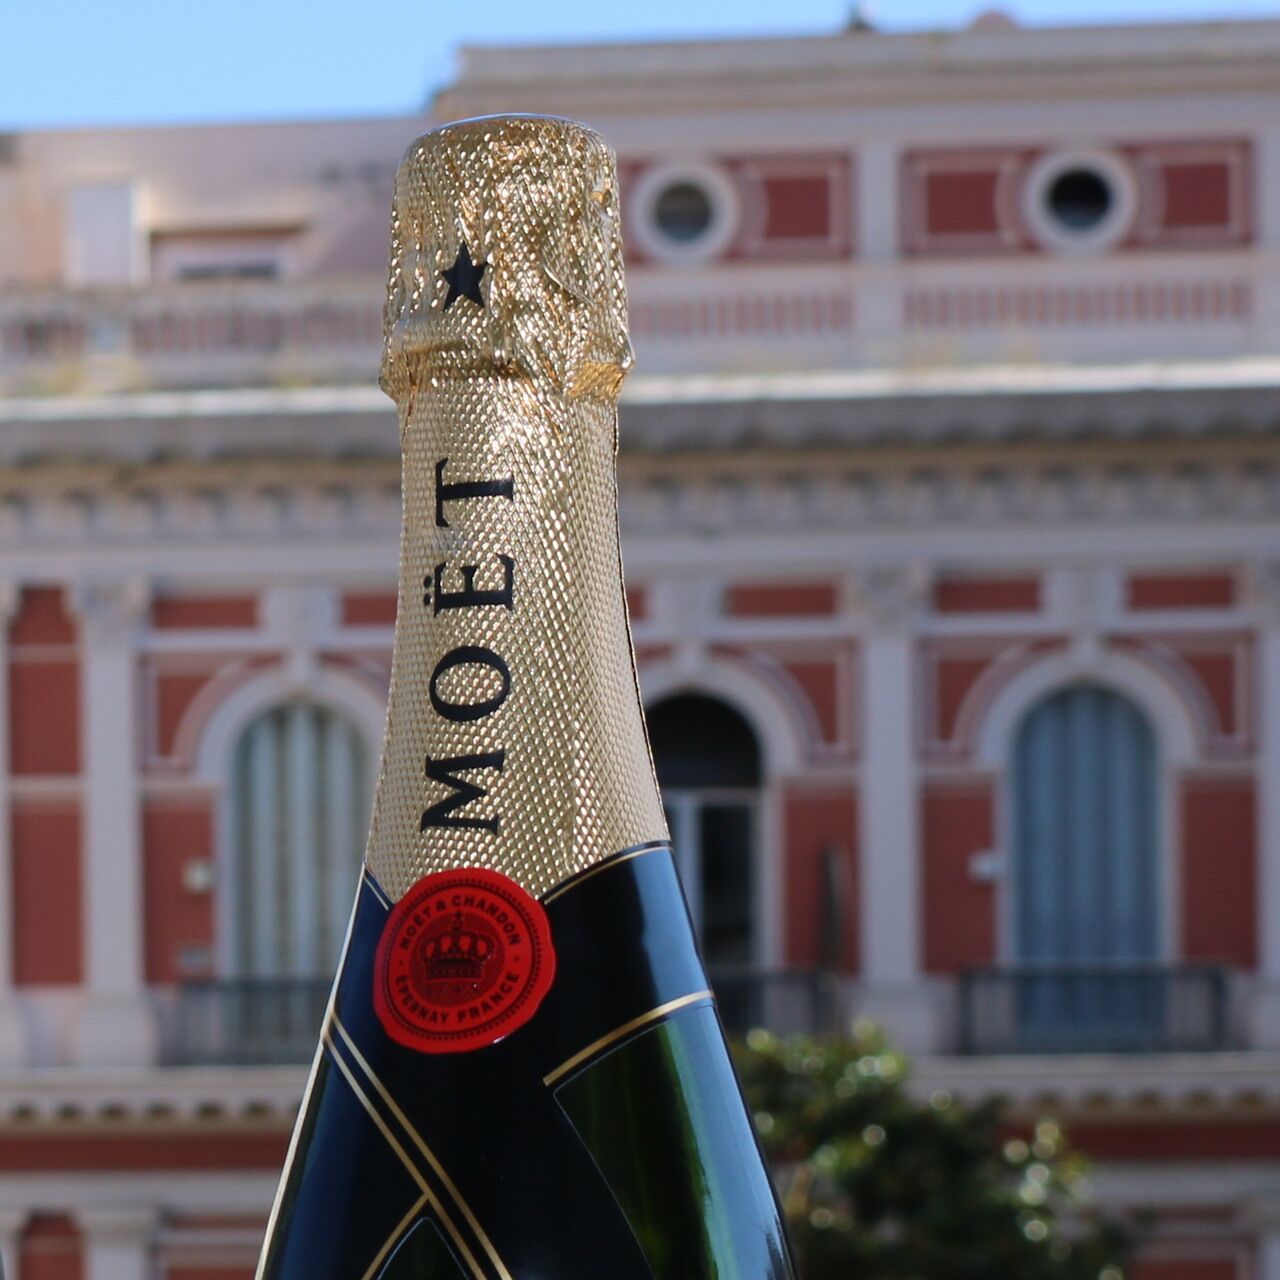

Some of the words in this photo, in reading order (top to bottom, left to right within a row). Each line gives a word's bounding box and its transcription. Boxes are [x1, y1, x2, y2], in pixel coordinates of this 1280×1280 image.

[421, 458, 515, 834] MOËT
[452, 895, 521, 945] CHANDON
[457, 970, 520, 1023] FRANCE
